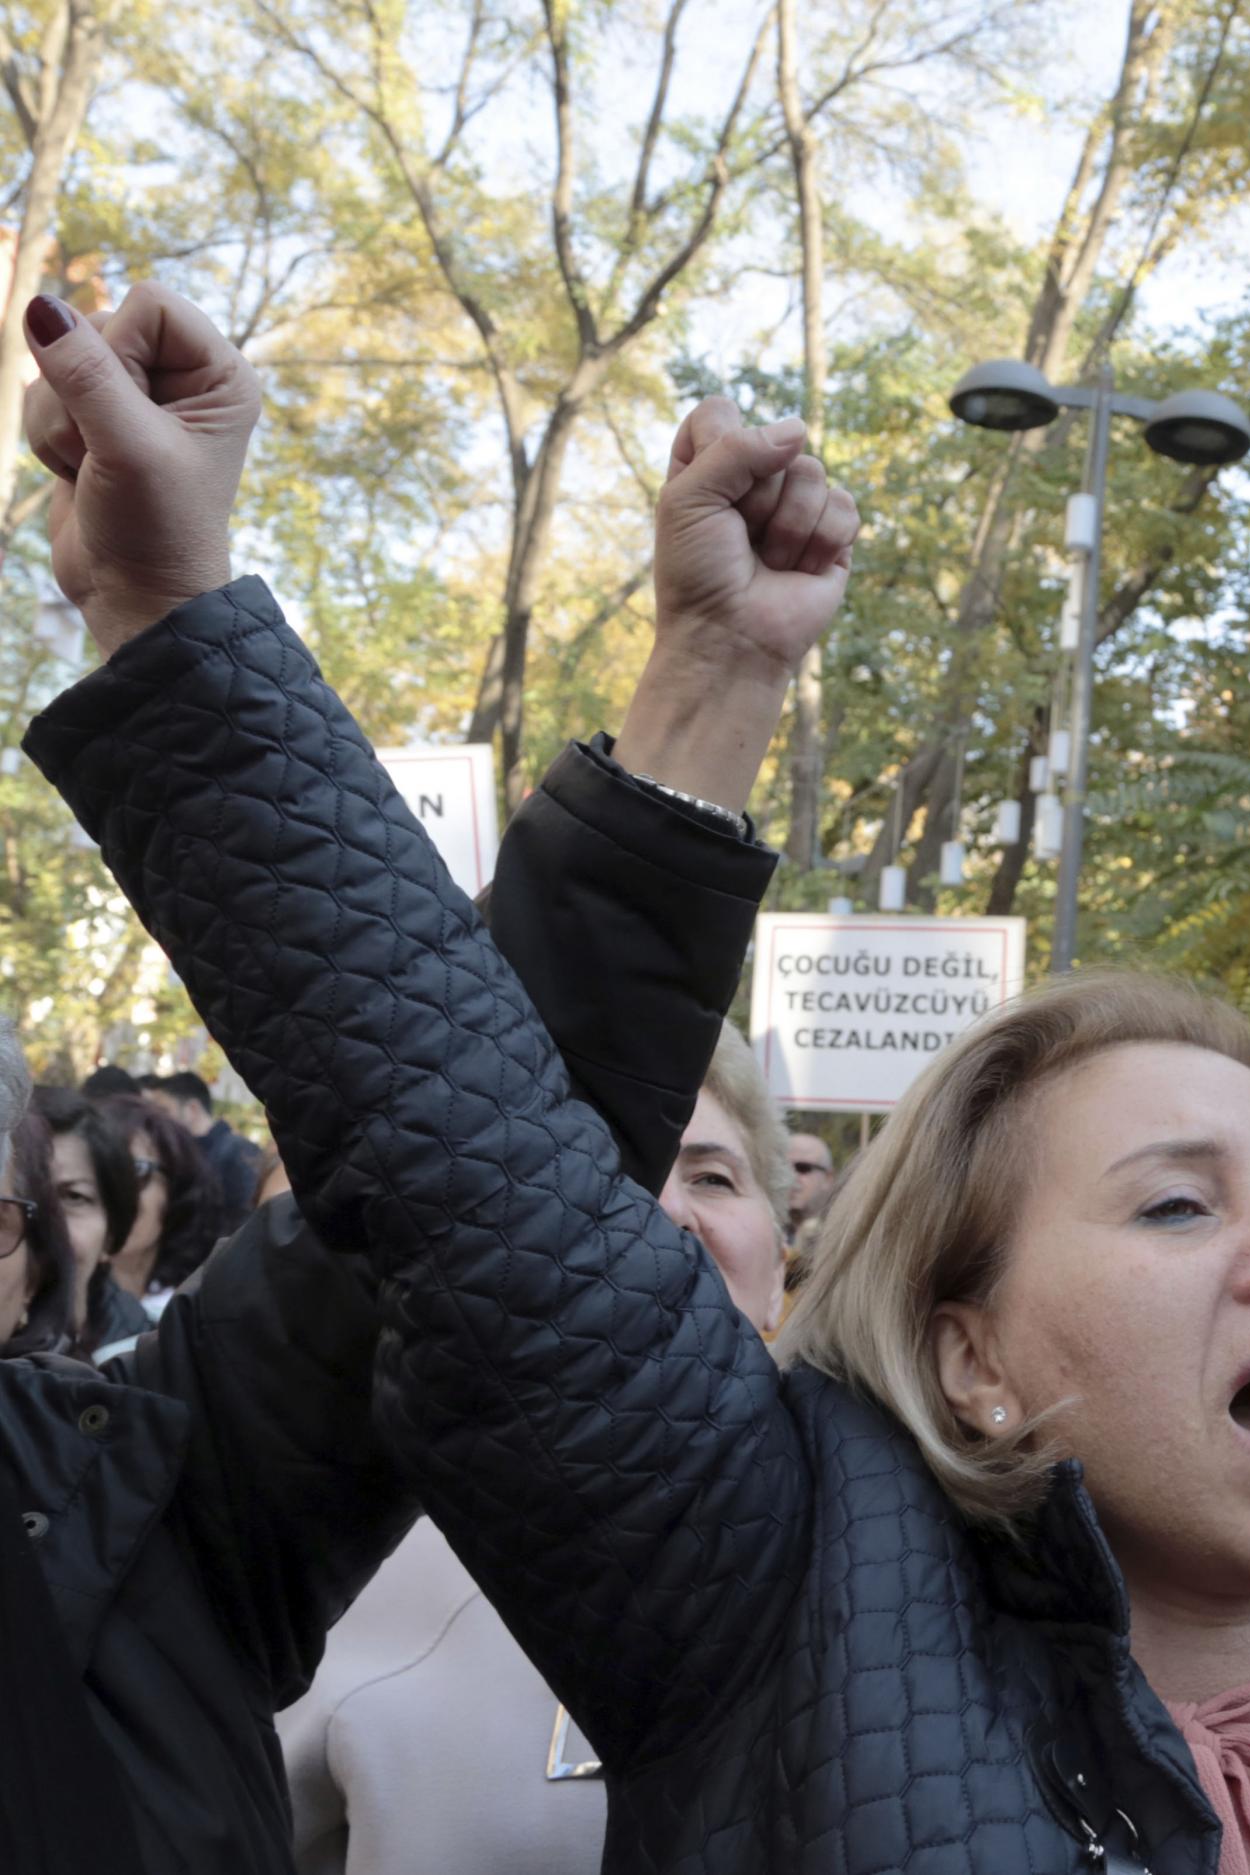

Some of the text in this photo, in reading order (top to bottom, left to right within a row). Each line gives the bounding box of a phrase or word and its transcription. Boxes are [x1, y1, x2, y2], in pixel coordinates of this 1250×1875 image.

[777, 950, 998, 980] ÇOCUĞU DEĞİL,
[786, 988, 989, 1015] TECAVÜZCÜYÜ
